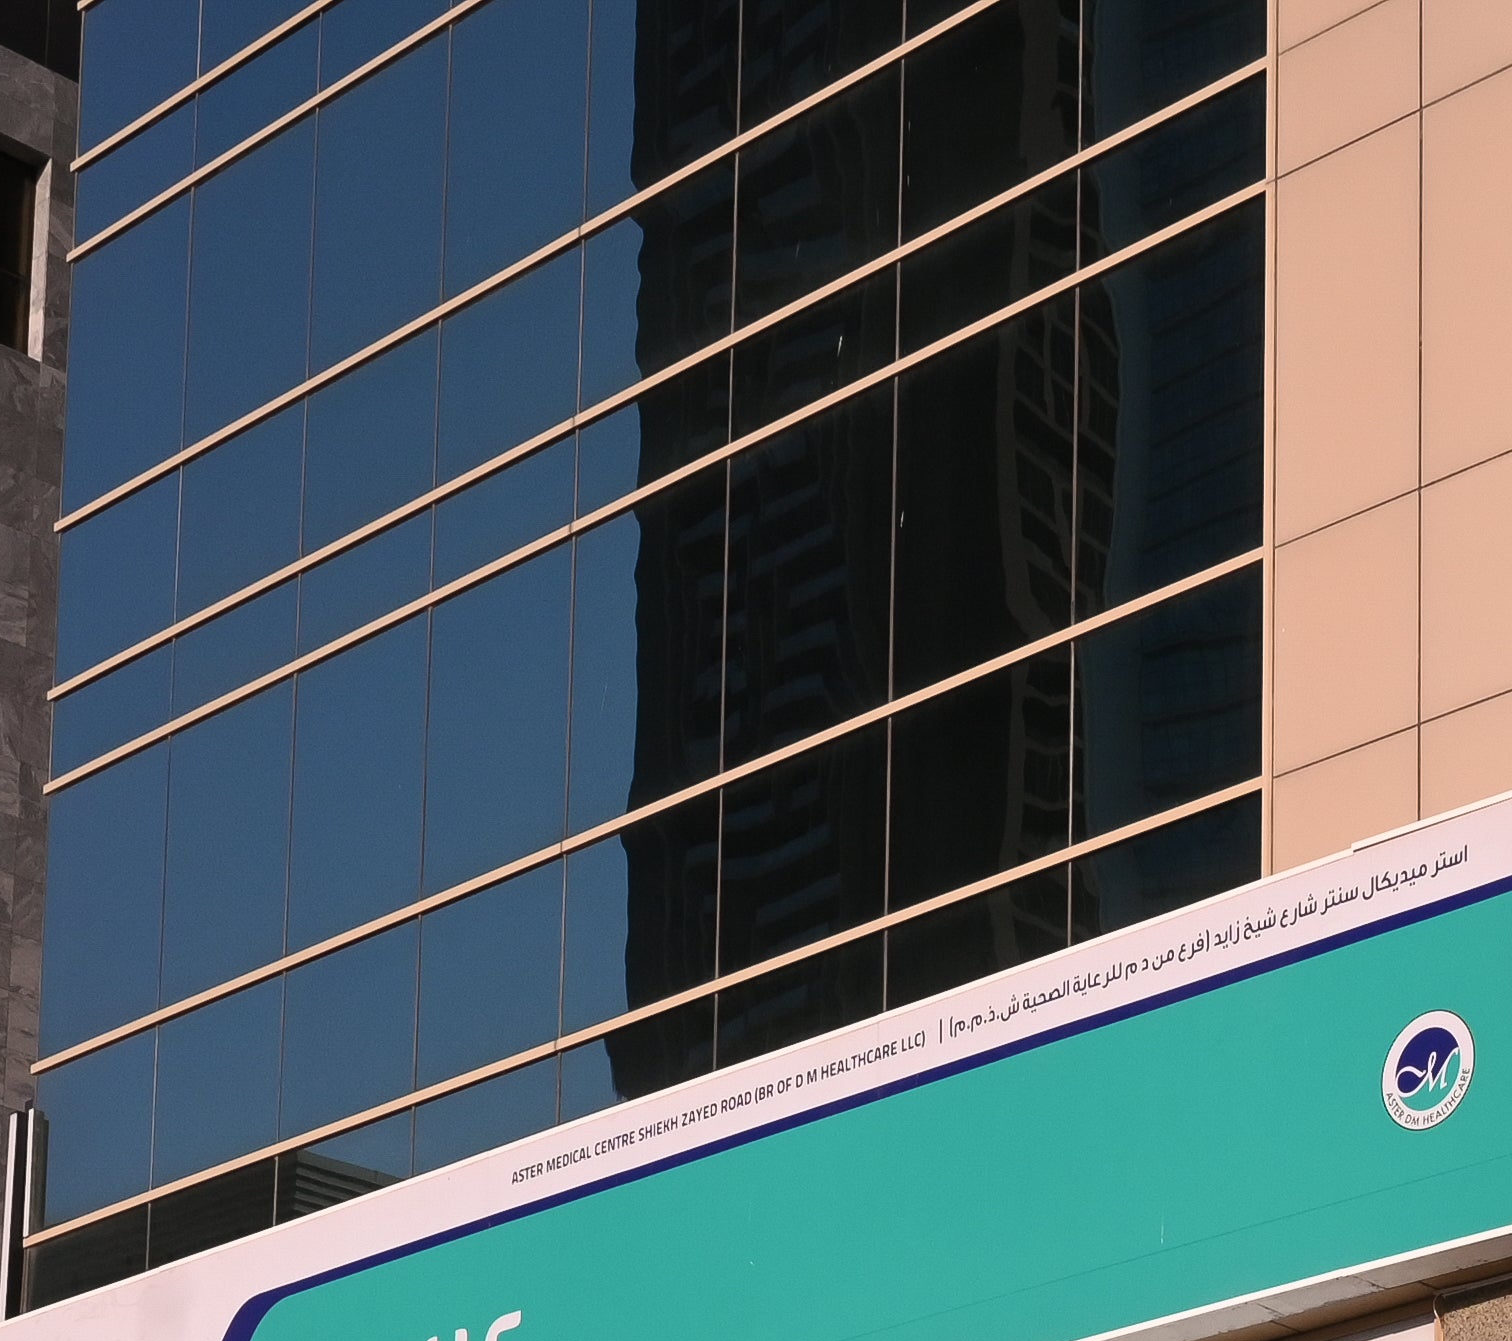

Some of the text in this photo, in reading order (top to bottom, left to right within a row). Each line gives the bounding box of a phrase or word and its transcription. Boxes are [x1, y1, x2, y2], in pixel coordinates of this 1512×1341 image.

[1022, 844, 1468, 1012] استر ميديكال سنتر شارع شيخ زايد من الصحية
[511, 1031, 926, 1184] ASTER MEDICAL CENTRE SHIEKH ZAYED ROAD (BR OF D M HEALTHCARE LLC)
[1386, 1068, 1471, 1126] ASTER DM HEALTHCARE
